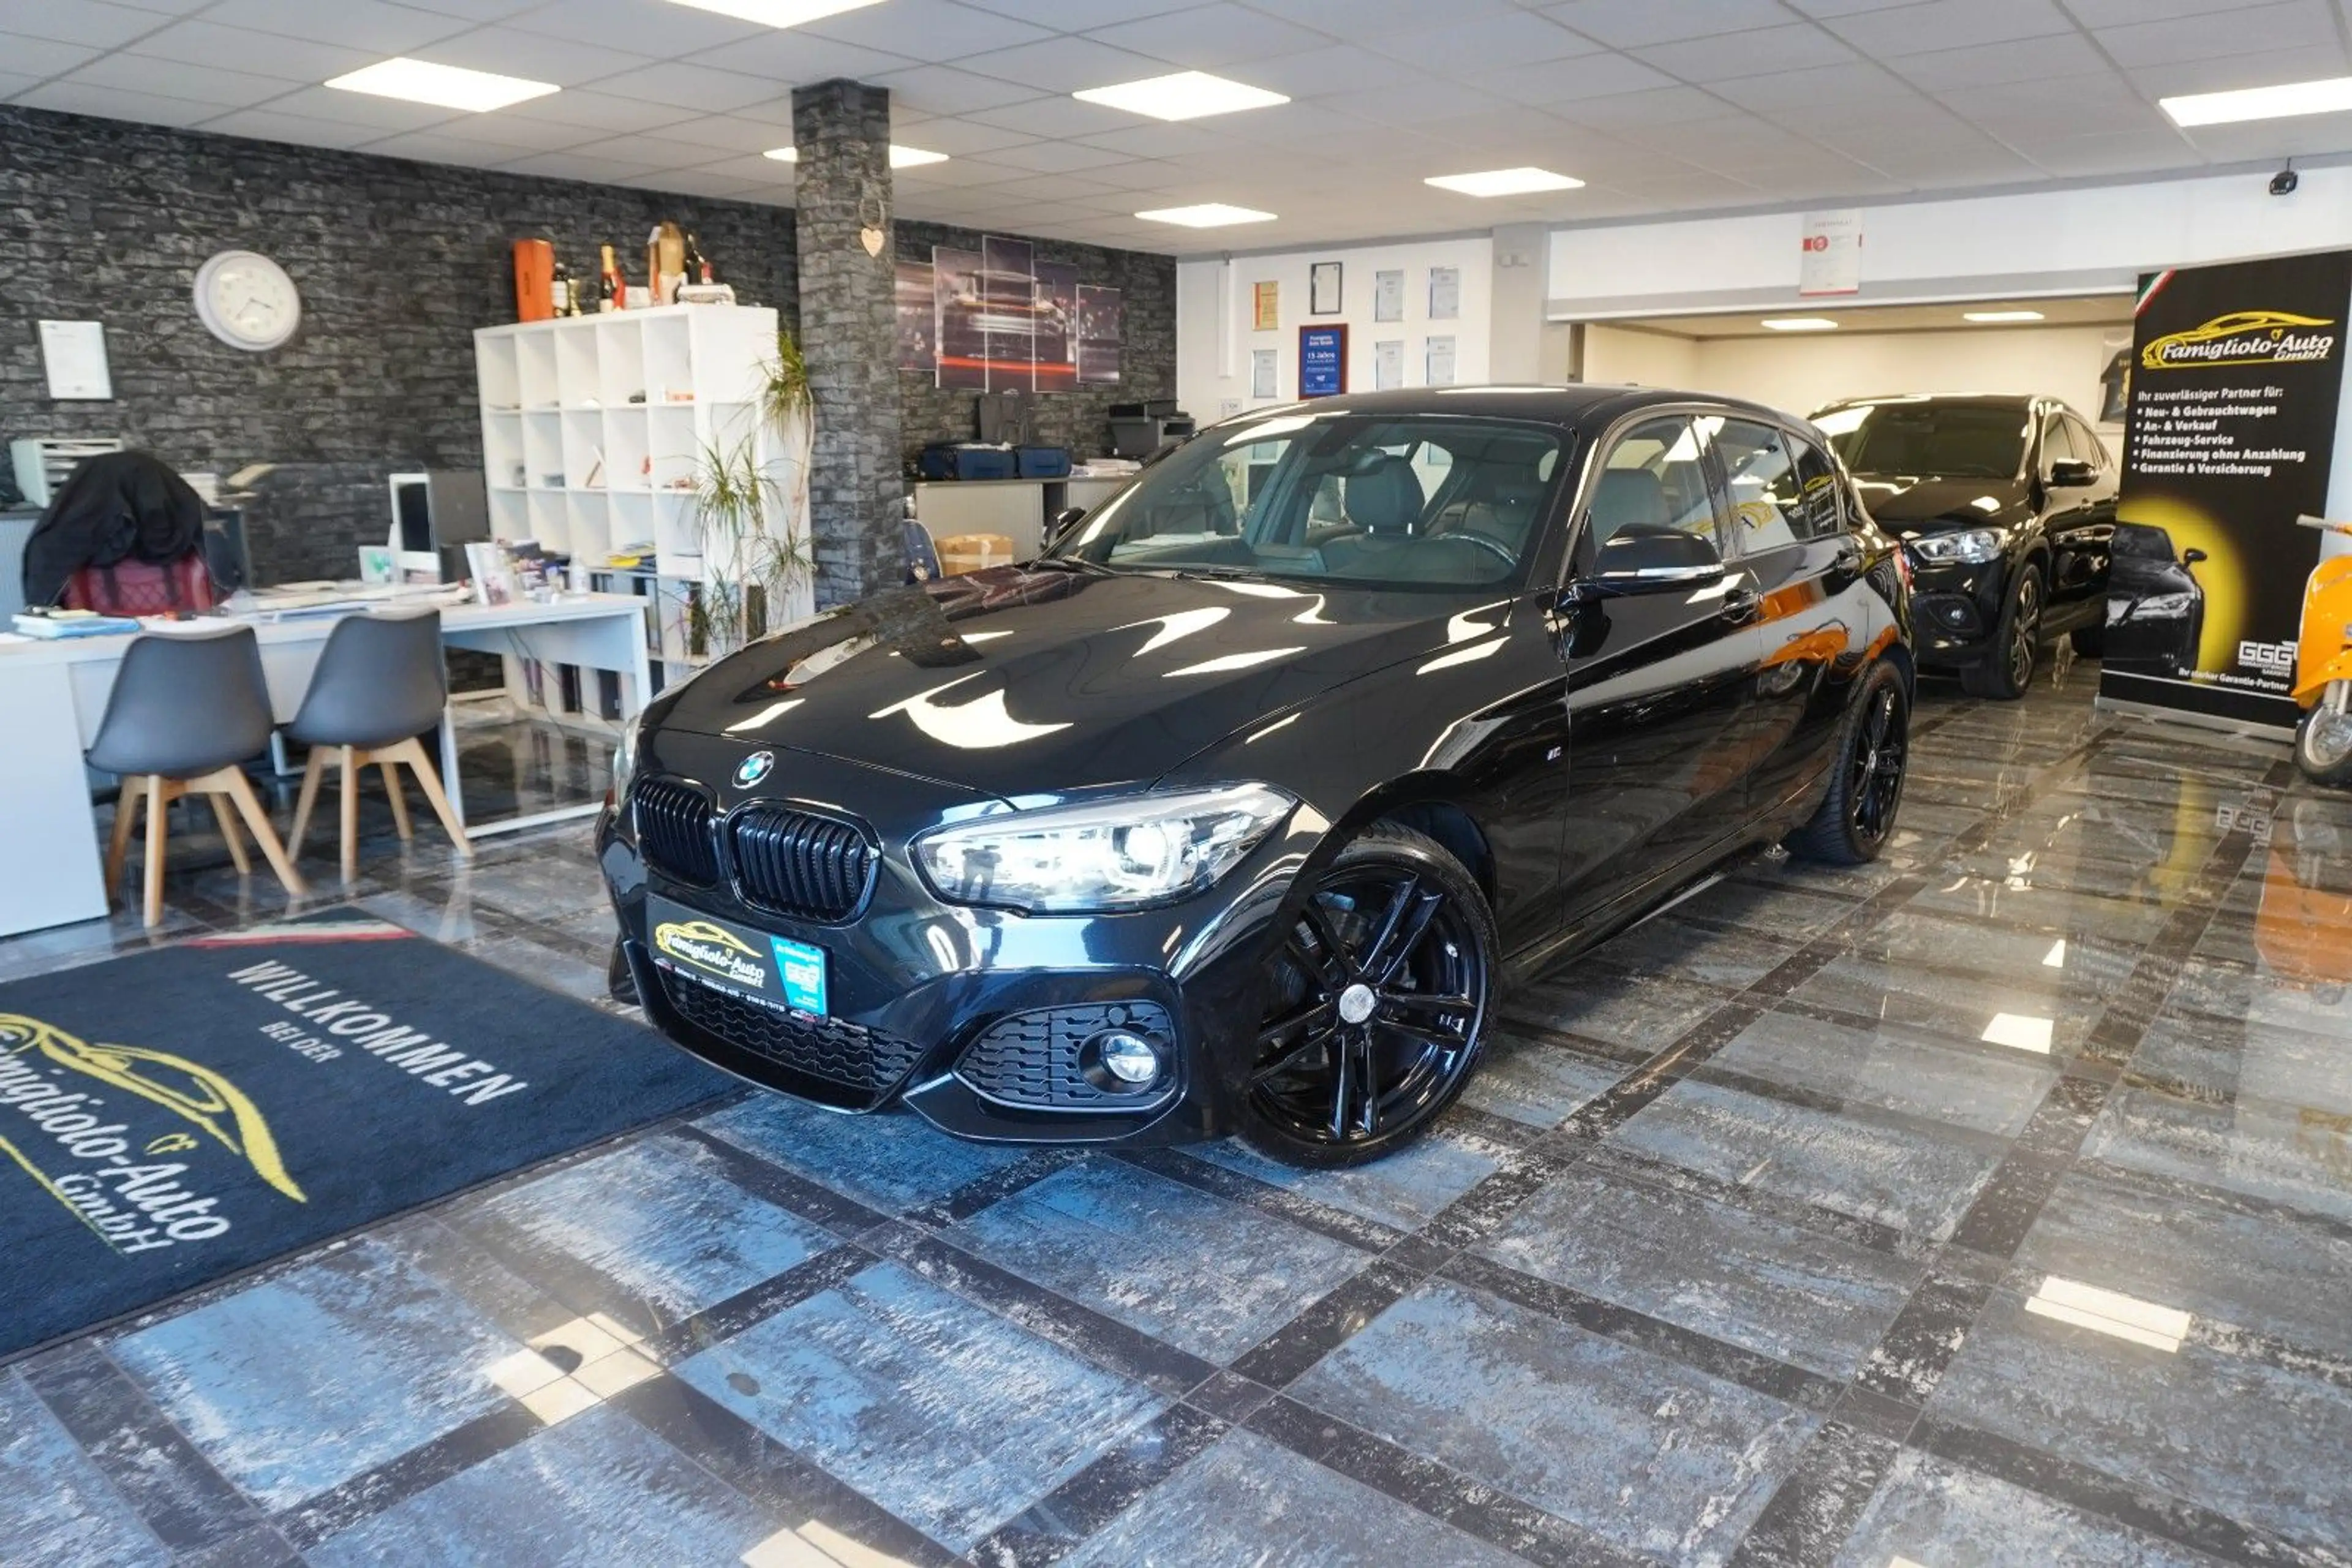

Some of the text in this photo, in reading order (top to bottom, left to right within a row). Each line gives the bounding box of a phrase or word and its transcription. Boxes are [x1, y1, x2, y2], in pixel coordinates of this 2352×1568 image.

[2162, 334, 2334, 359] Famigliolo-Auto
[2273, 349, 2328, 360] GmbH
[2138, 386, 2284, 402] Ihr zuverlässiger Partner für:
[2145, 405, 2277, 417] Neu- & Gebrauchtwagen
[2143, 420, 2218, 431] An- & Verkauf
[2142, 434, 2234, 447] Fahrzeug-Service
[2141, 448, 2305, 462] Finanzierung ohne Anzahlung
[2139, 463, 2272, 477] Garantie & Versicherung
[2239, 641, 2294, 665] GGG
[667, 933, 765, 978] Famigliolo-Auto
[226, 960, 529, 1106] WILLKOMMEN
[259, 1021, 344, 1063] BEI DER
[54, 1173, 174, 1253] GmbH
